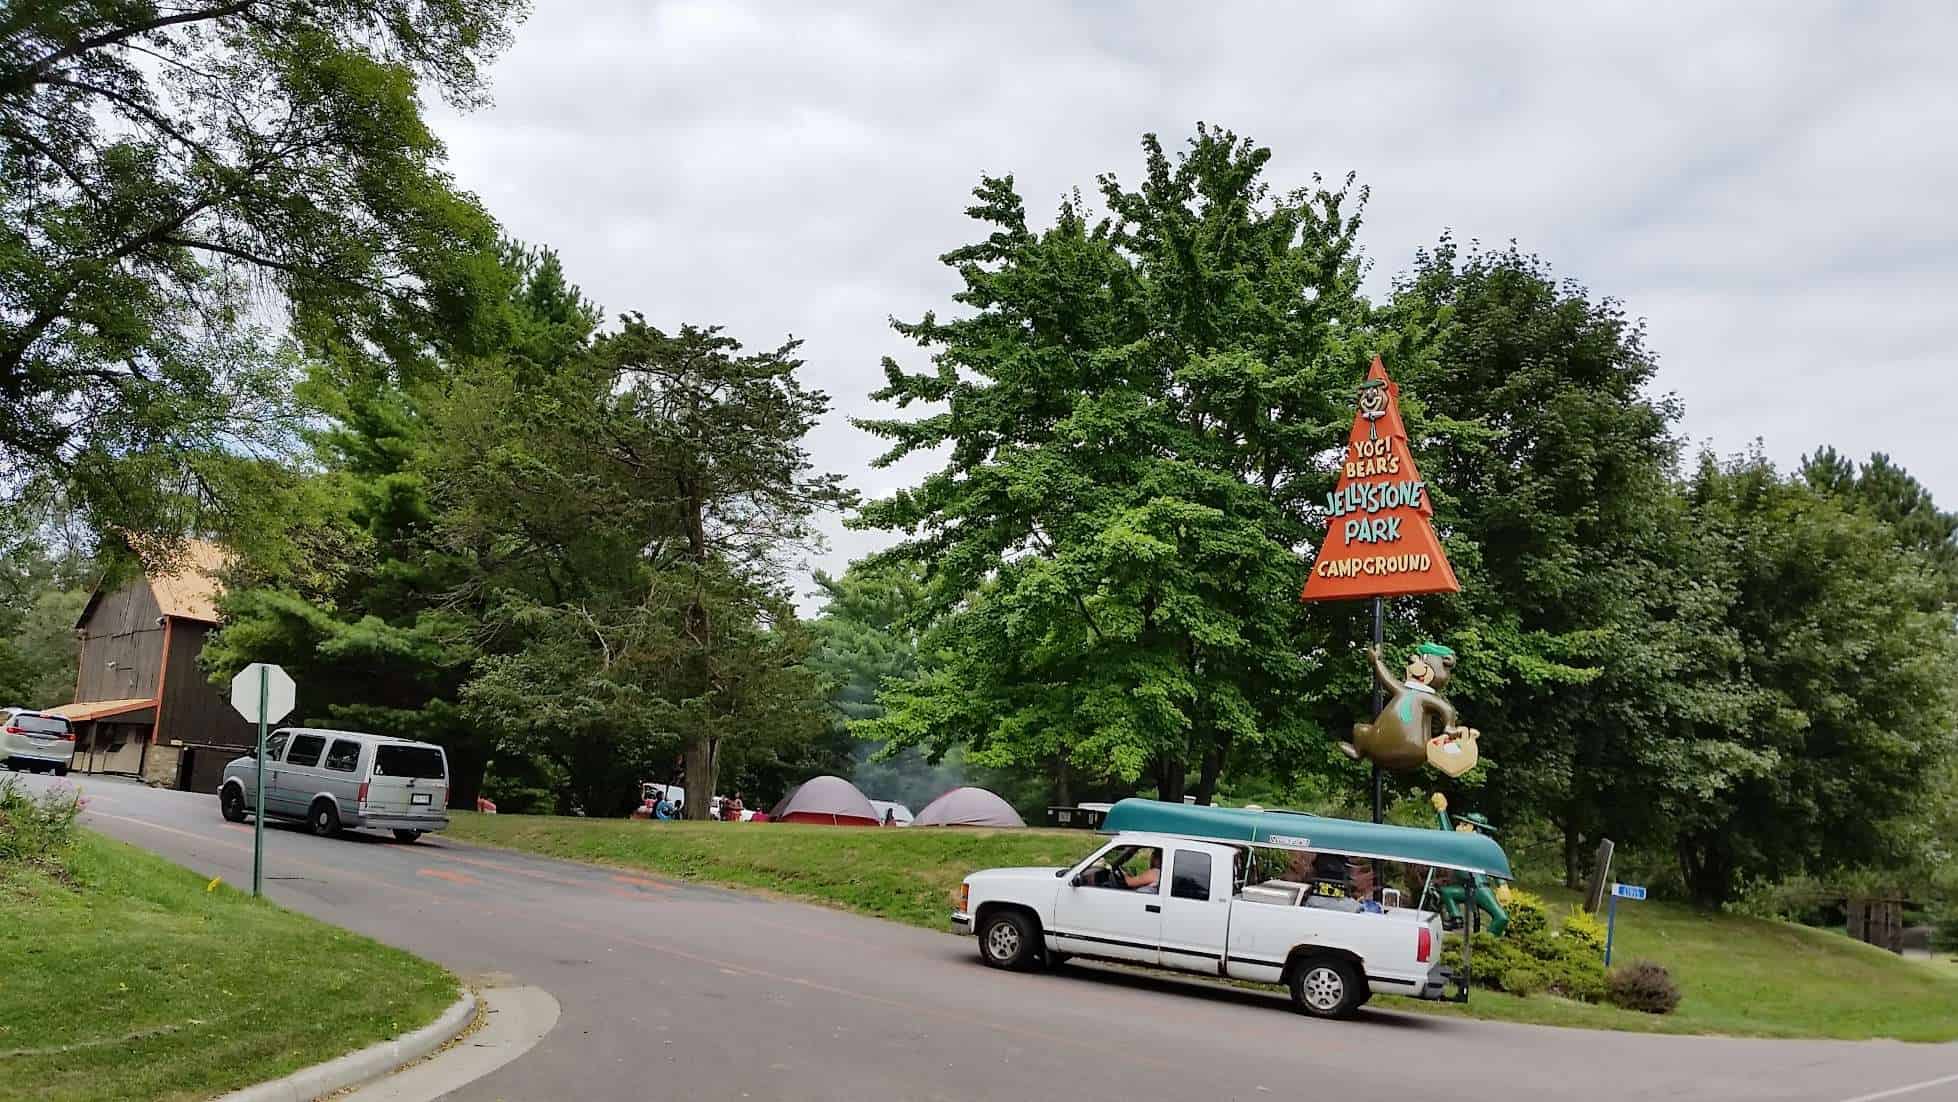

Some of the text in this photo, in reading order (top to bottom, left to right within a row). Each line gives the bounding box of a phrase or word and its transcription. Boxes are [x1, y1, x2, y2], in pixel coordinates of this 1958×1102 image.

[1354, 437, 1392, 458] YOGI
[1345, 455, 1400, 478] BEAR'S
[1325, 481, 1425, 517] JELLYSTONE
[1345, 517, 1401, 545] PARK
[1317, 553, 1431, 577] CAMPGROUND
